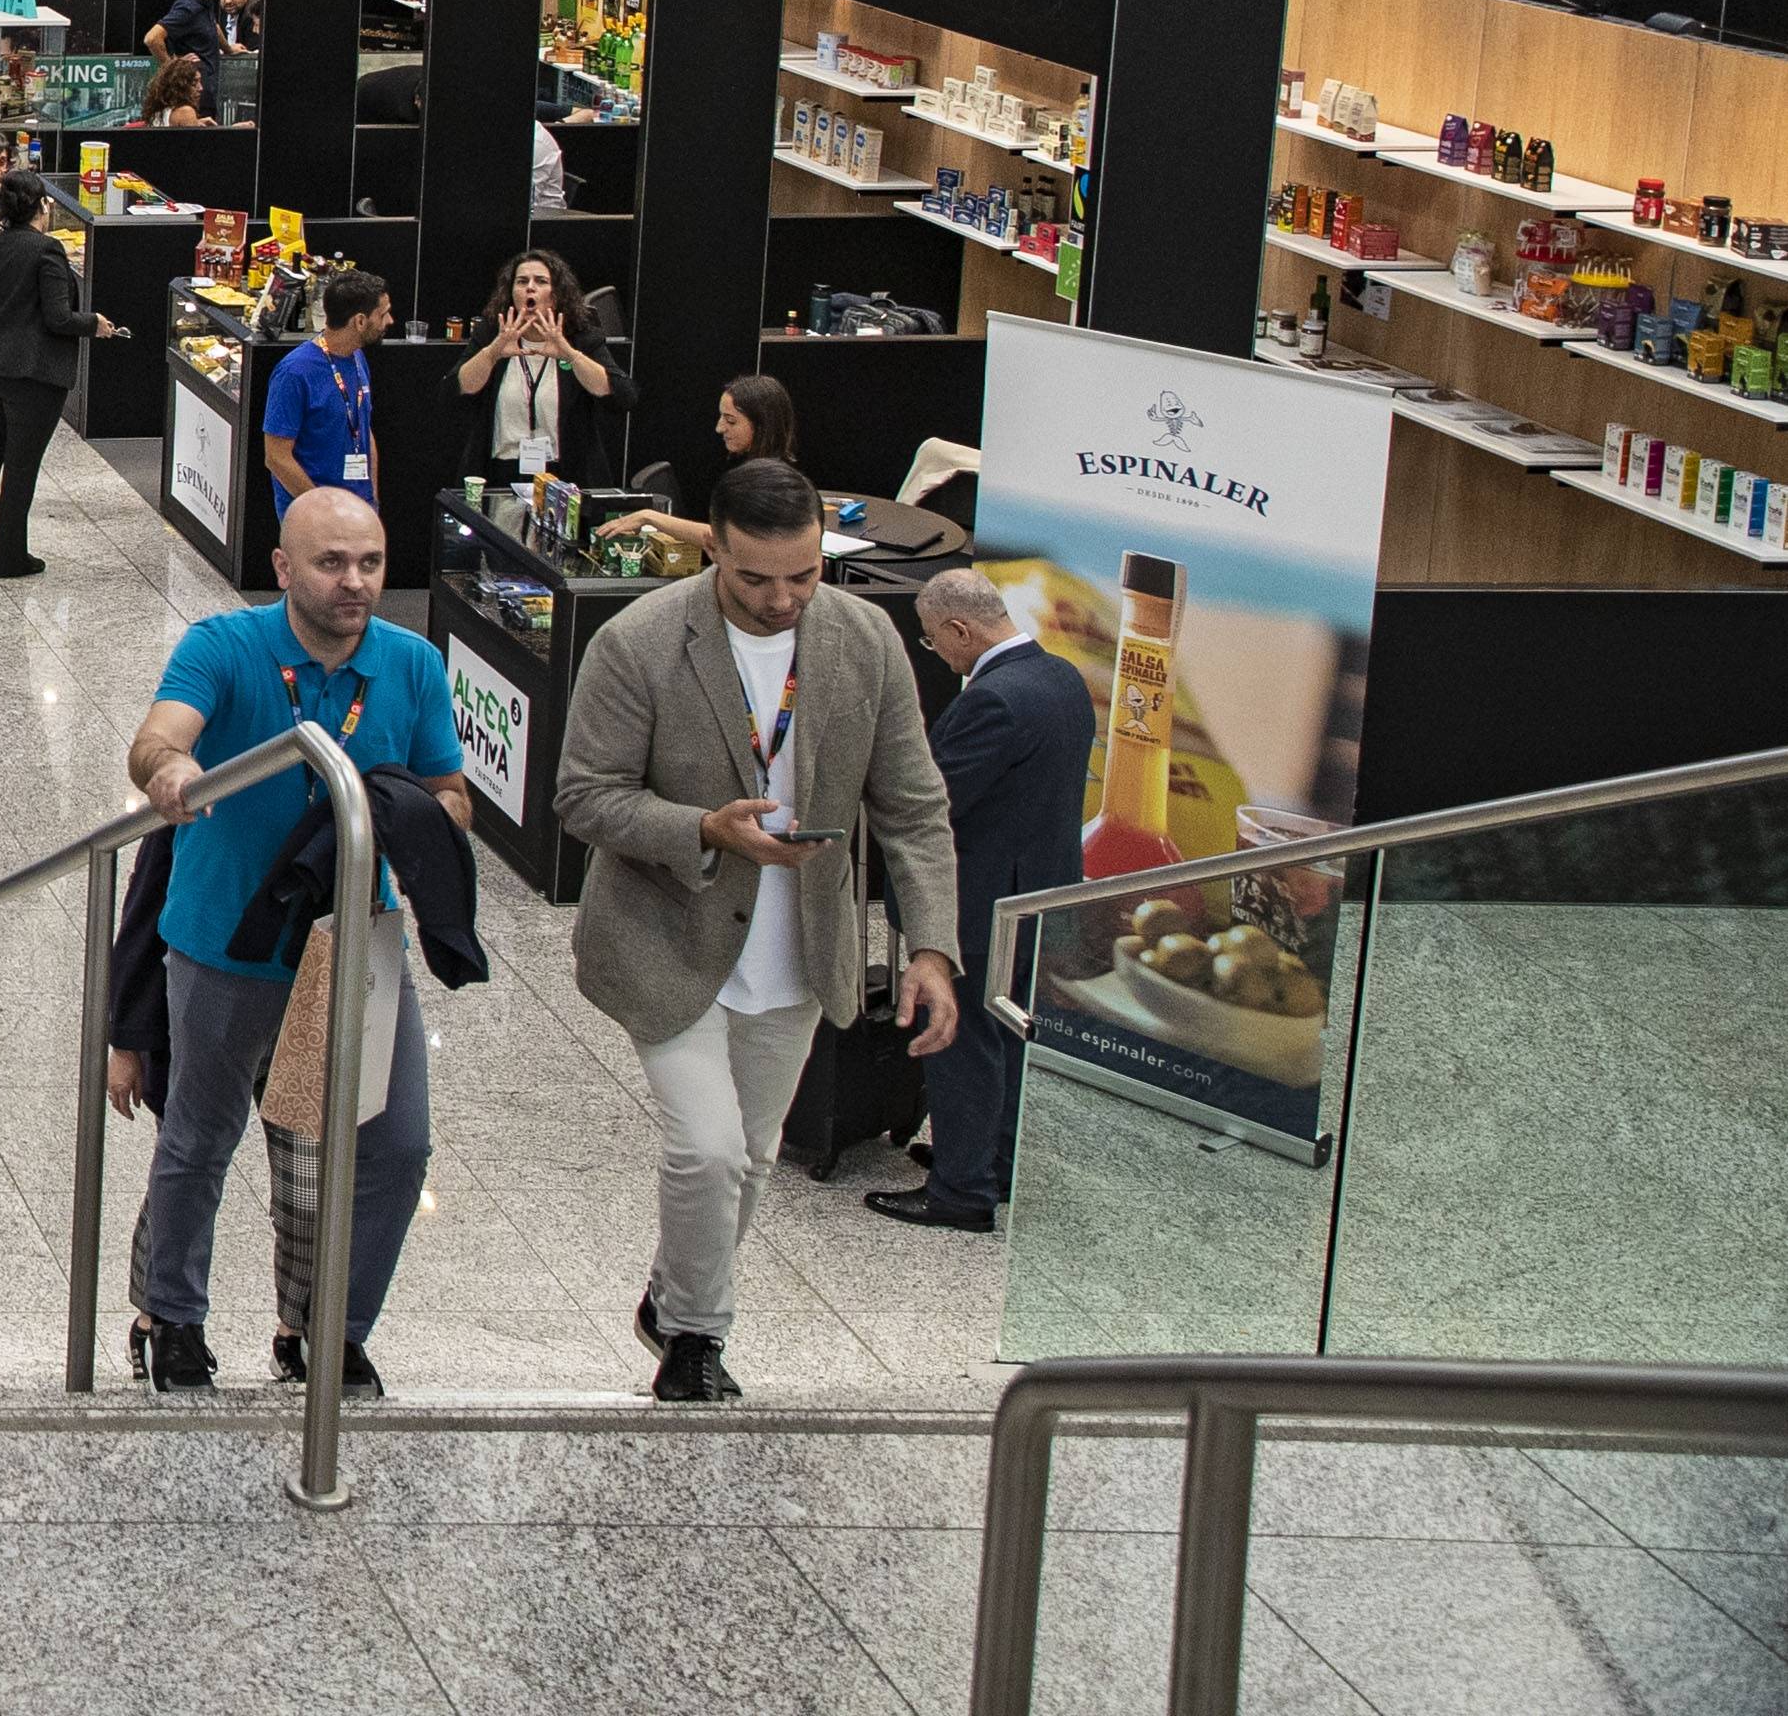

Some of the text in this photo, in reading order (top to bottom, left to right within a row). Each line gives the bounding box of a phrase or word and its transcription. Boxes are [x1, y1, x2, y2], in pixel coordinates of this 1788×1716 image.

[176, 462, 227, 527] ESPINALER
[1075, 451, 1270, 518] ESPINALER
[1137, 487, 1172, 503] DESDE
[1120, 648, 1165, 673] SALSA
[452, 668, 513, 751] ALTER
[474, 765, 504, 800] FAIRTRADE
[1031, 1013, 1213, 1086] enda.espinaler.com
